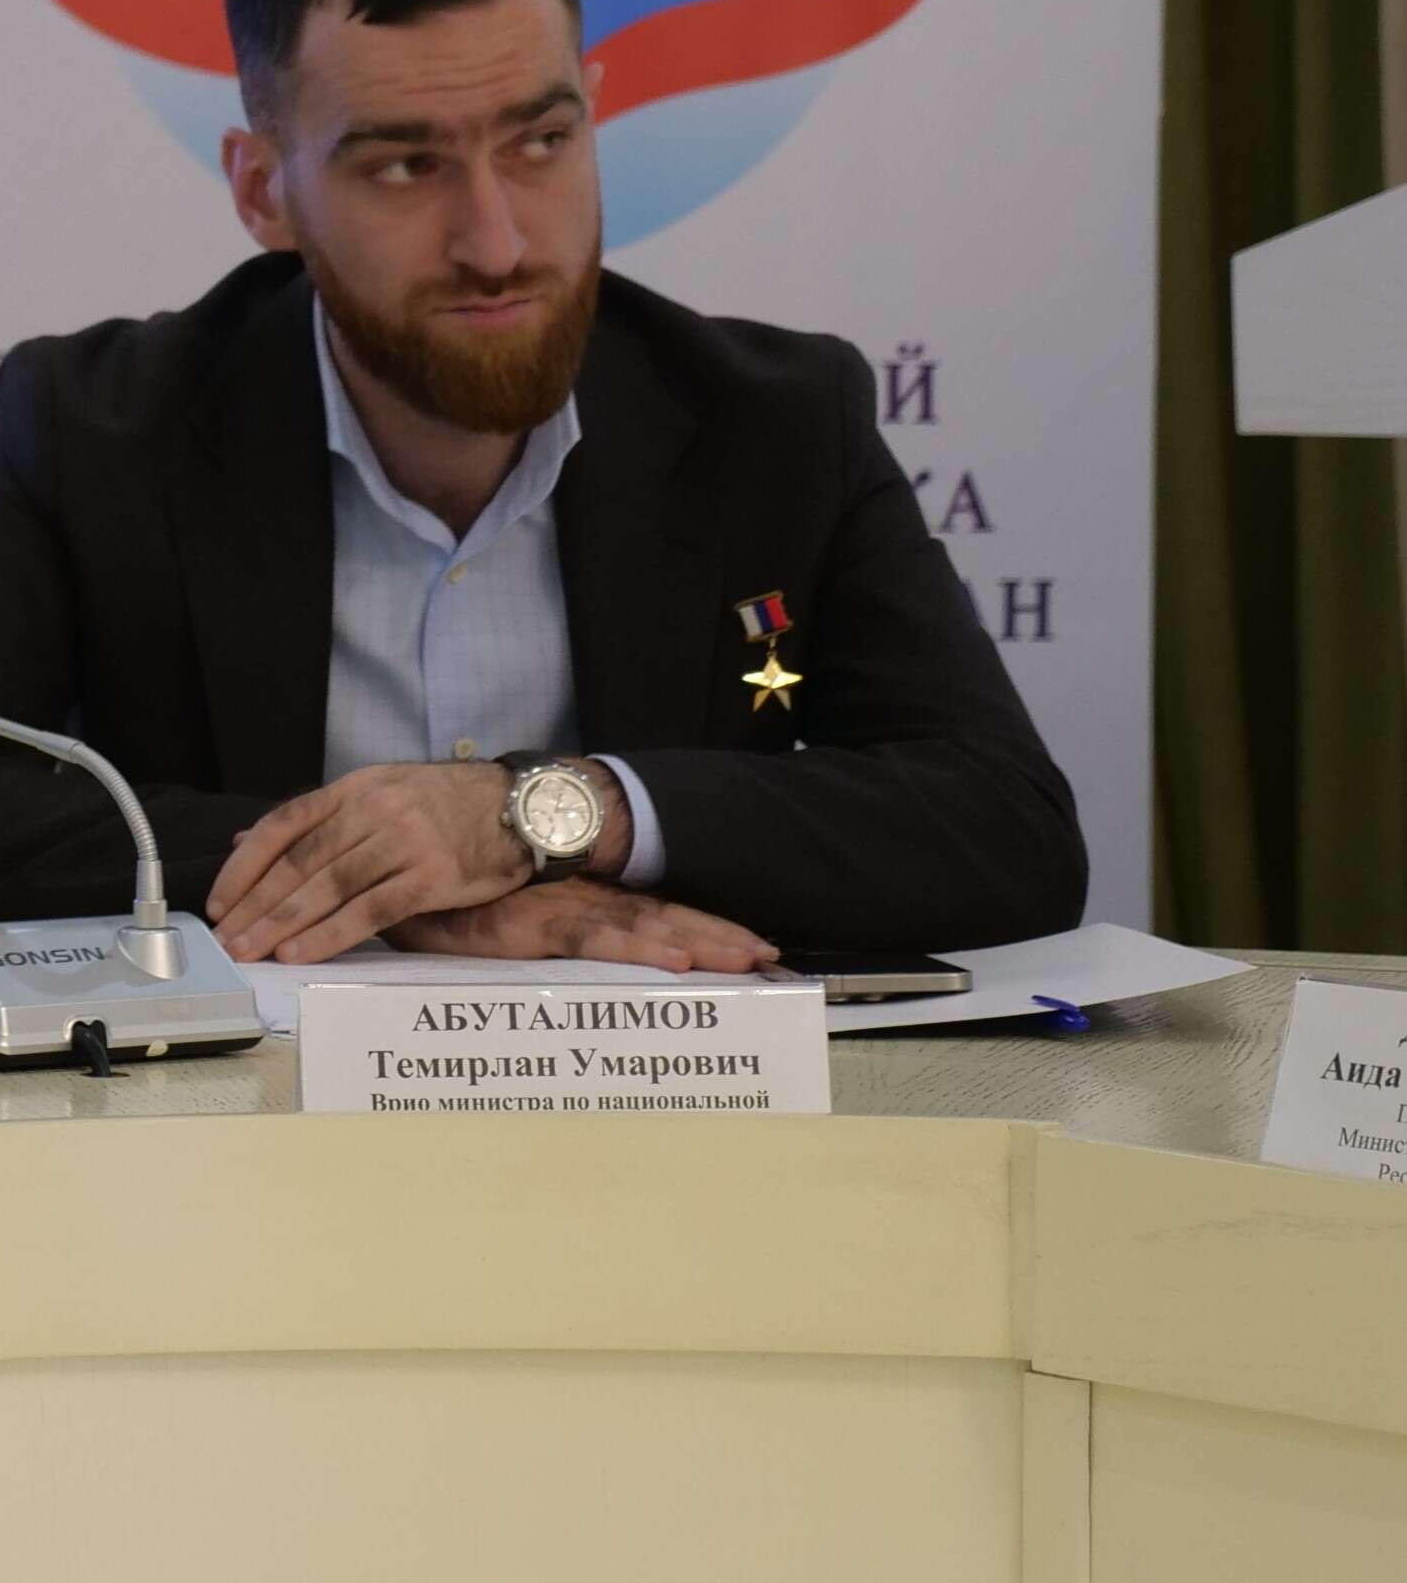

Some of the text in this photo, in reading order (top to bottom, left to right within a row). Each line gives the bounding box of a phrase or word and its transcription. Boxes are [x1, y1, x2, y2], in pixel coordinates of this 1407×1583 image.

[411, 999, 719, 1033] АБУТАЛИМОВ
[368, 1047, 762, 1086] Темирлан Умарович
[1319, 1051, 1402, 1091] Аида
[370, 1089, 771, 1112] Врио министра по национальной
